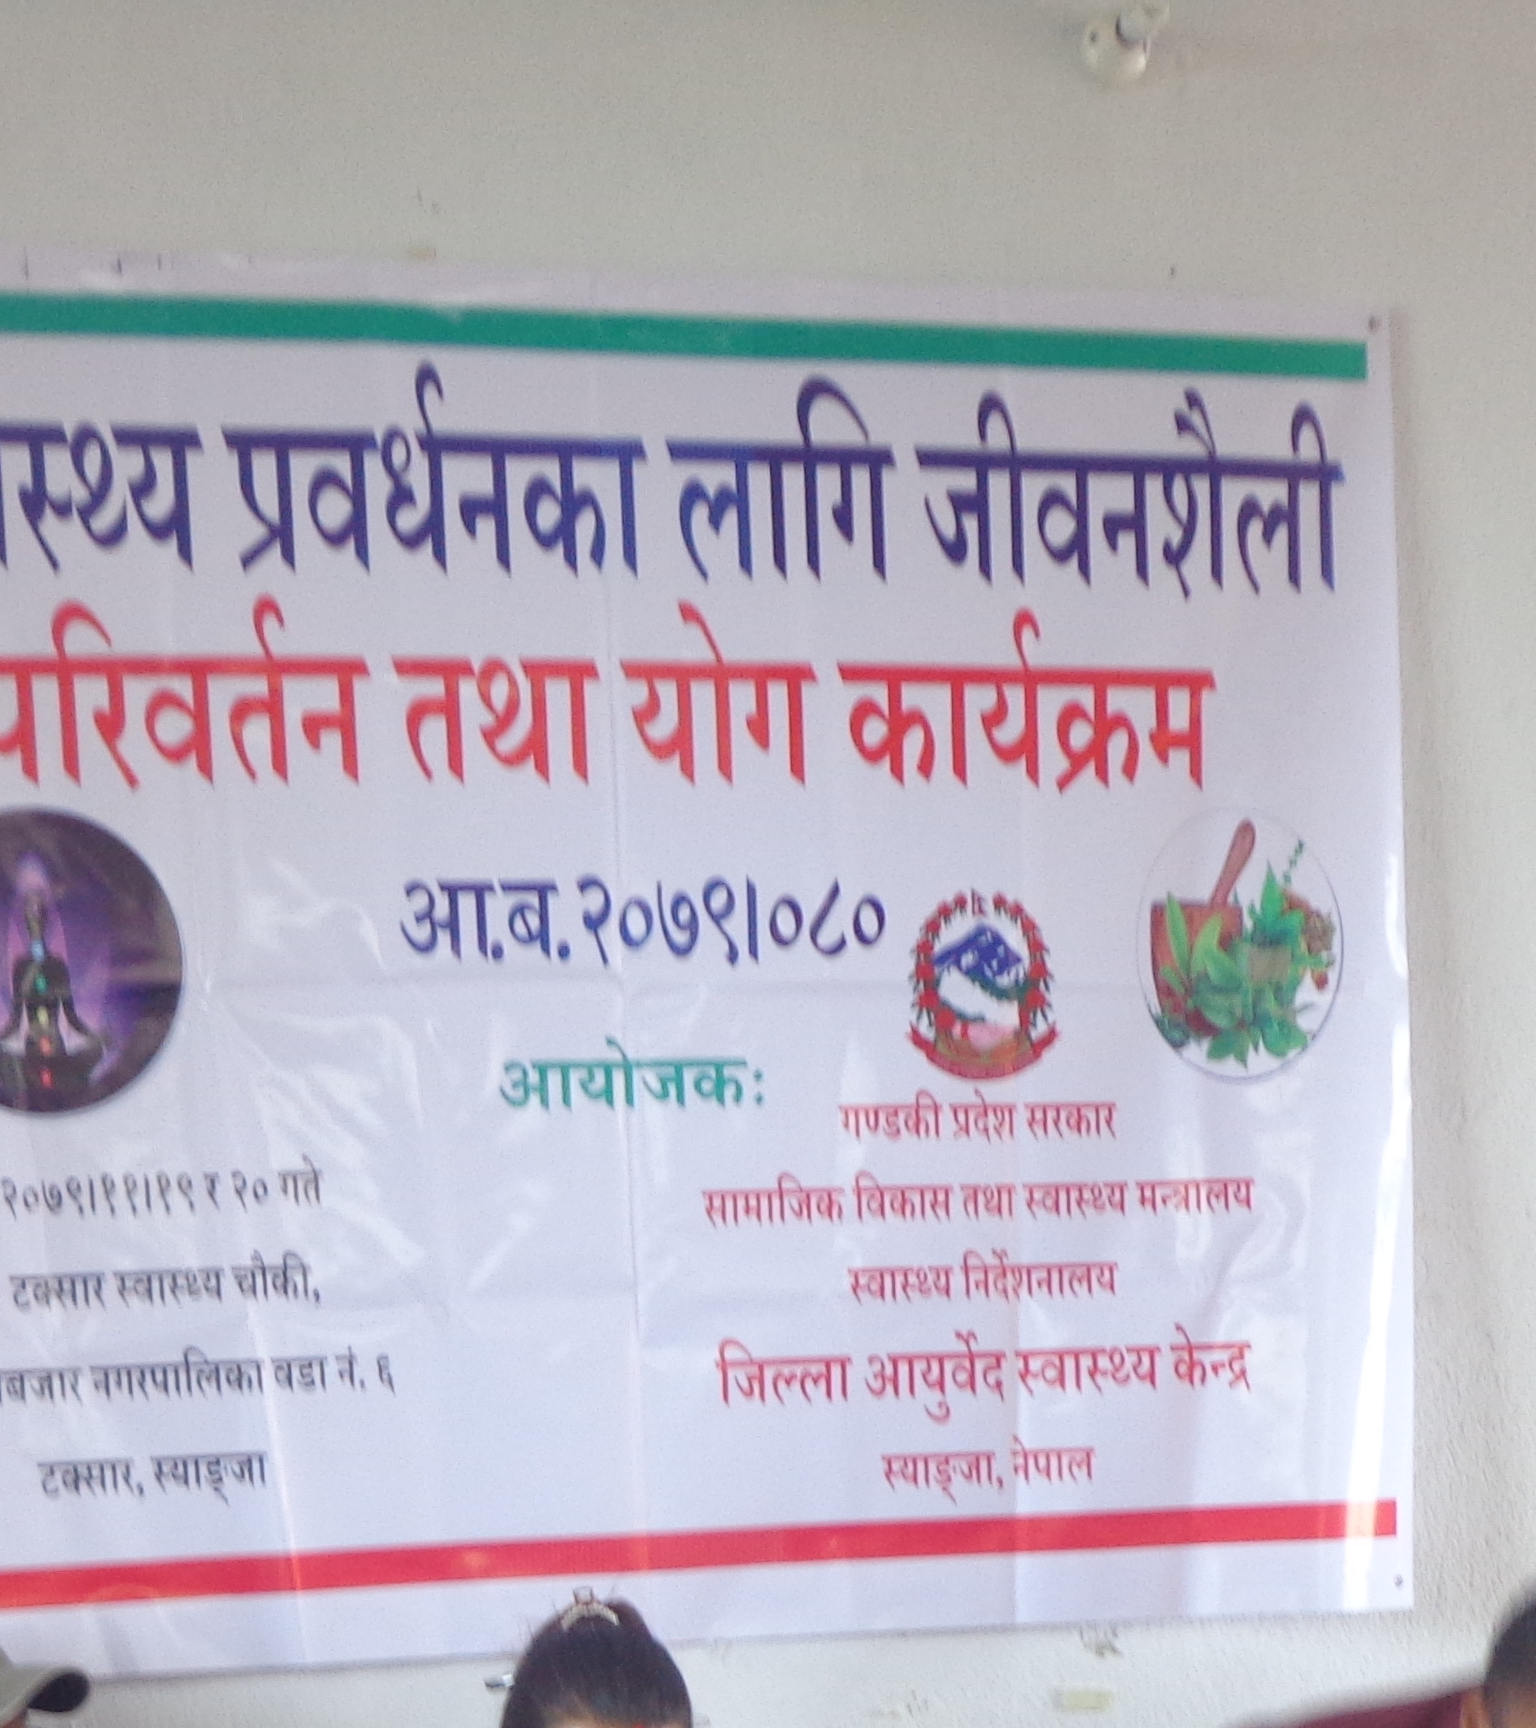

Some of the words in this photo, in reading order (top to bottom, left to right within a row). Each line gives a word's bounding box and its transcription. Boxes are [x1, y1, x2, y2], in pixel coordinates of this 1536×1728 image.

[222, 360, 648, 578] प्रवर्धनका
[667, 376, 894, 582] लागि
[916, 386, 1344, 598] जीवनशैली
[392, 654, 599, 786] तथा
[620, 600, 816, 786] योग
[838, 608, 1216, 796] कार्यक्रम
[839, 1088, 943, 1141] गण्डकी
[949, 1088, 1015, 1145] प्रदेश
[1025, 1100, 1118, 1142] सरकार
[278, 1154, 323, 1207] गते
[702, 1172, 844, 1227] सामाजिक
[852, 1170, 954, 1224] विकास
[960, 1180, 1016, 1221] तथा
[1022, 1180, 1129, 1218] स्वास्थ्य
[1135, 1176, 1255, 1216] मन्त्रालय
[9, 1272, 107, 1312] टक्सार
[113, 1268, 225, 1308] स्वास्थ्य
[848, 1266, 954, 1306] स्वास्थ्य
[961, 1248, 1118, 1304] निर्देशनालय
[89, 1344, 265, 1400] नगरपालिका
[270, 1354, 328, 1391] वडा
[716, 1337, 852, 1405] जिल्ला
[864, 1331, 1006, 1424] आयुर्वेद
[1015, 1345, 1160, 1395] स्वास्थ्य
[1170, 1322, 1251, 1391] केन्द्र
[1010, 1434, 1095, 1486] नेपाल
